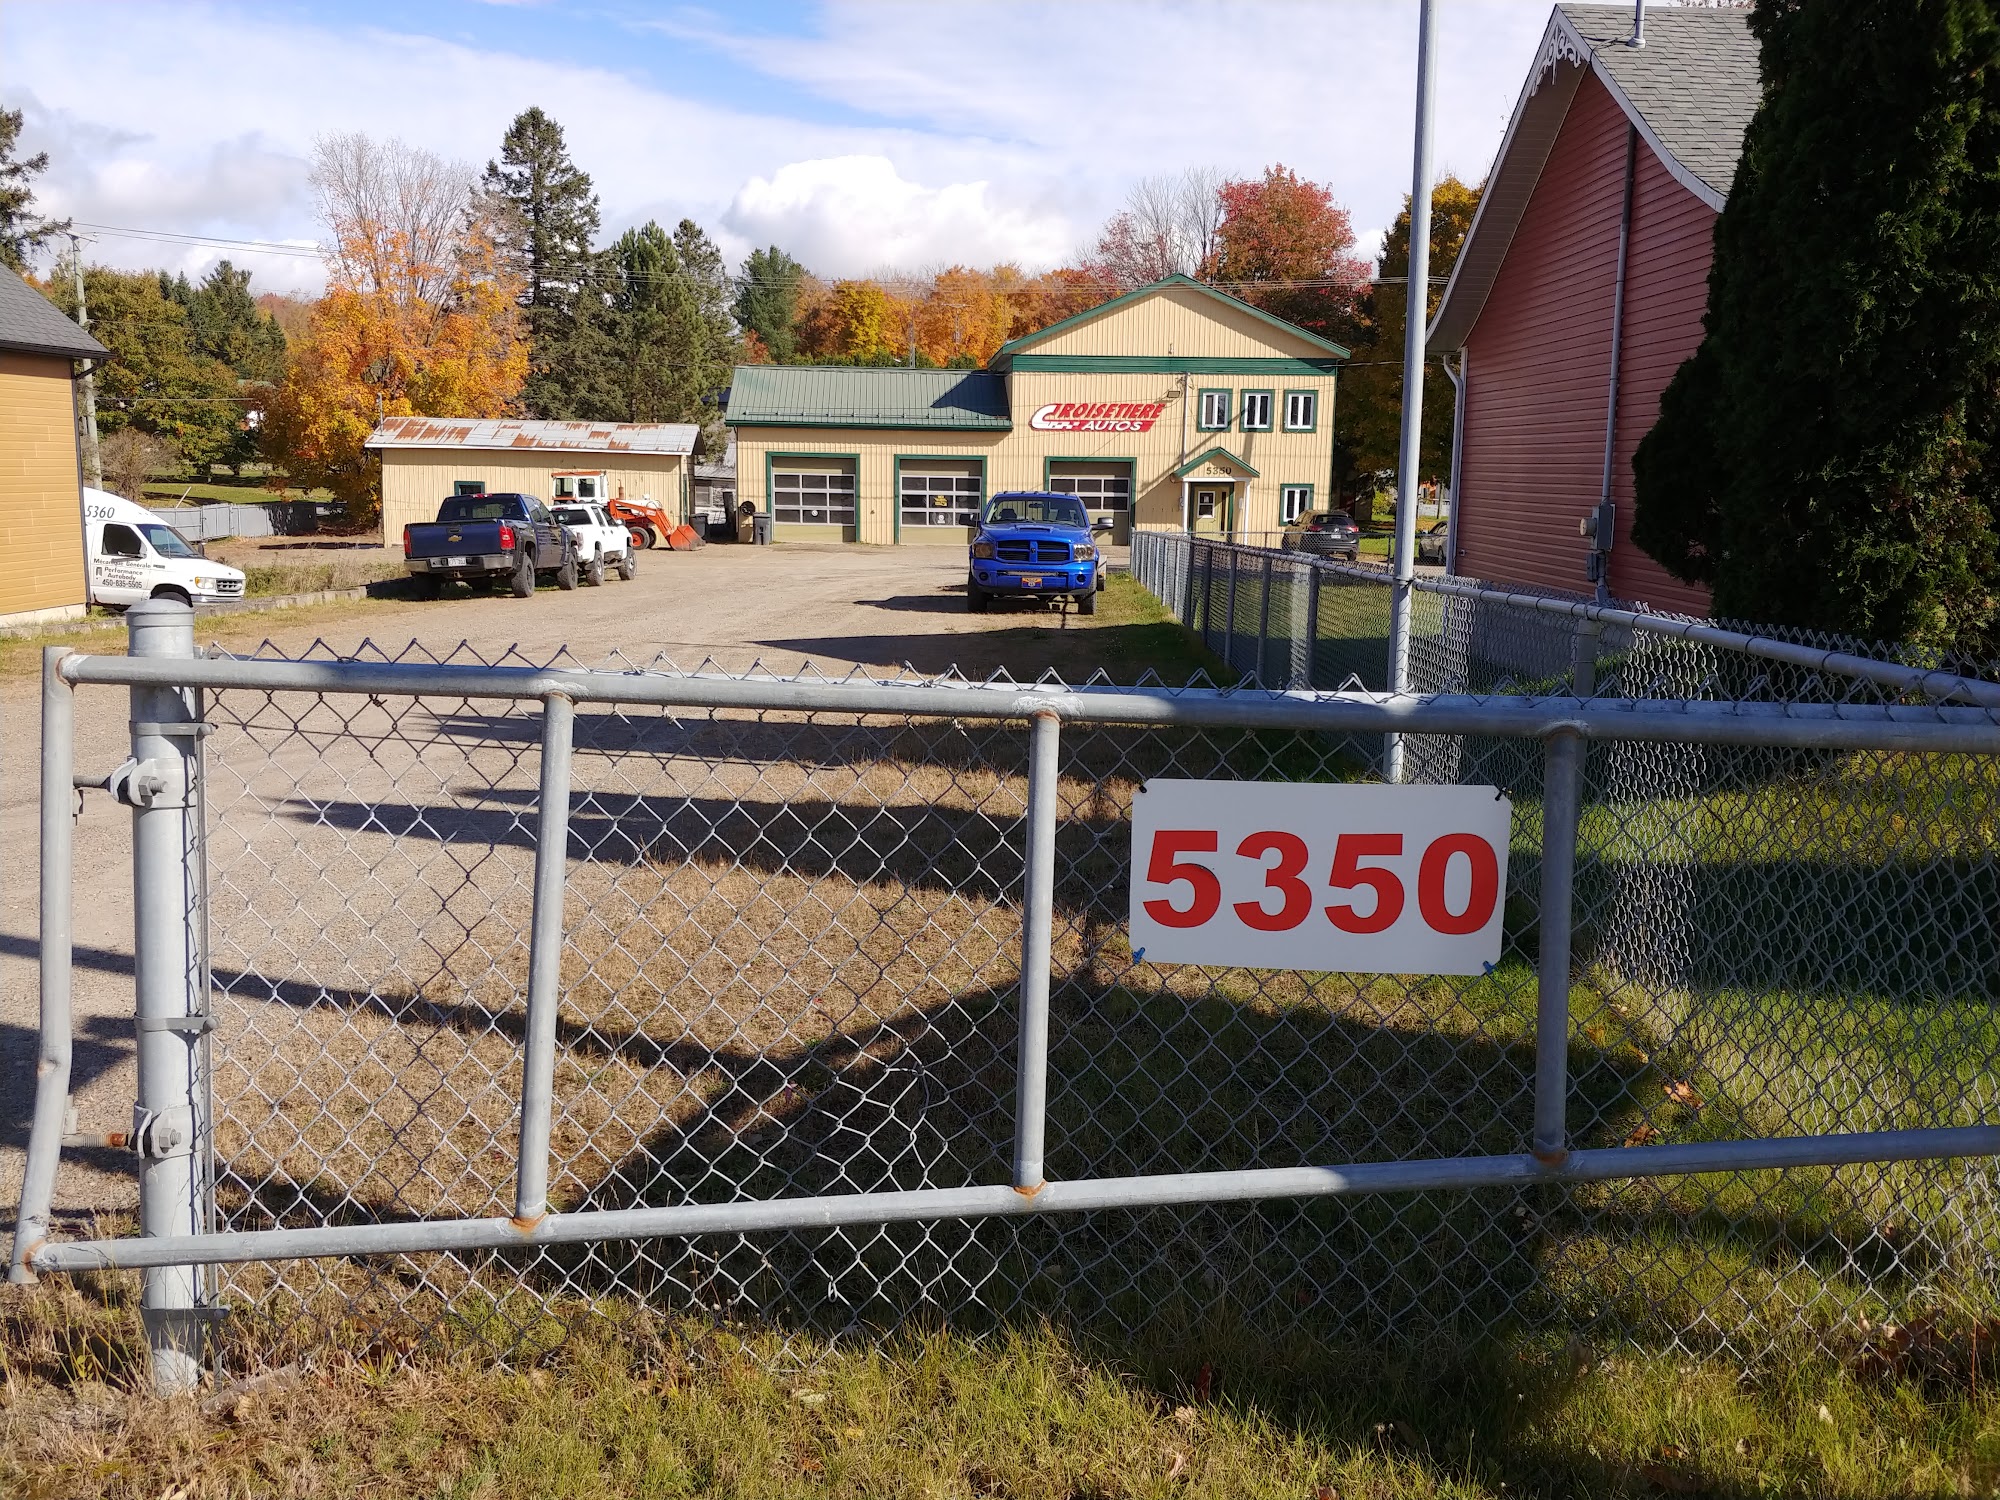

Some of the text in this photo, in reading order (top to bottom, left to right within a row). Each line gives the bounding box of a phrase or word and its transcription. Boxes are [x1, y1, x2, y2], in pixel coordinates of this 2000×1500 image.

[1082, 420, 1142, 431] AUTOS
[1206, 466, 1232, 475] 5350
[84, 505, 115, 519] 5360
[94, 558, 124, 566] Mécanque
[105, 567, 143, 575] Performance
[102, 579, 143, 588] 450-835-5505
[1142, 830, 1499, 935] 5350
